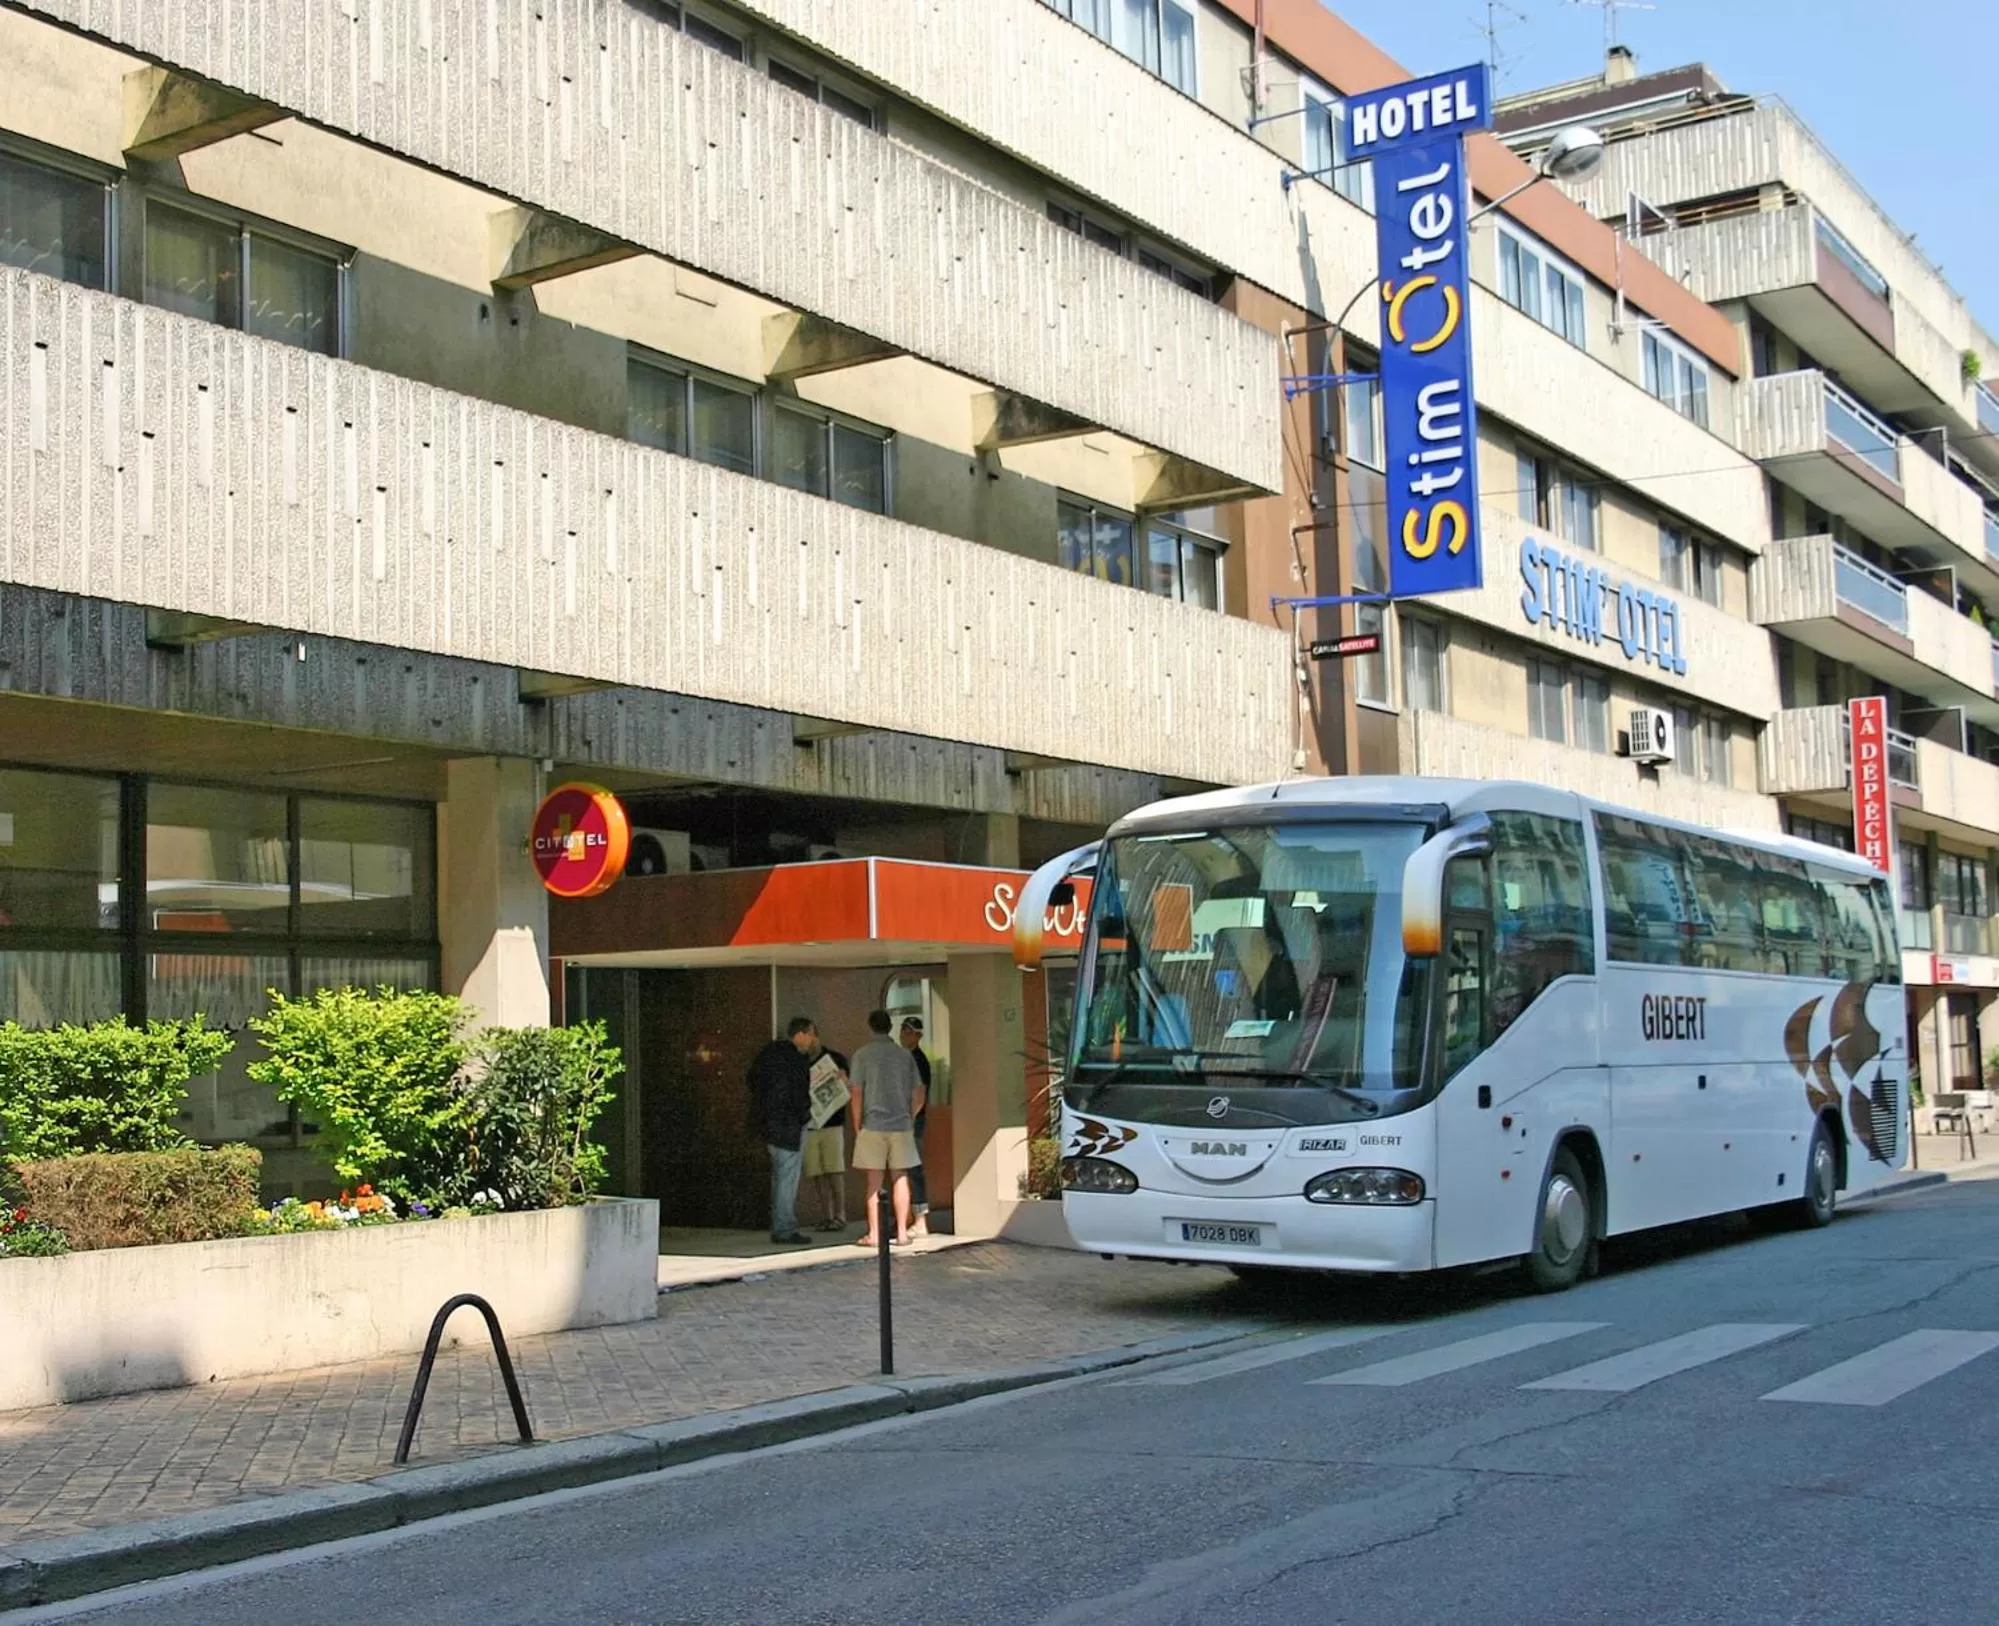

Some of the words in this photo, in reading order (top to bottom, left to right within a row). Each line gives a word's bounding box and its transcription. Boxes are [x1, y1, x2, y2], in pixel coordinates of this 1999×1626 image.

[1353, 80, 1477, 146] HOTEL
[1403, 378, 1469, 559] Stim
[1859, 701, 1877, 735] LA
[1641, 993, 1707, 1041] GIBERT
[1190, 1141, 1247, 1157] MAN
[1298, 1138, 1347, 1151] IRIZAR
[1359, 1134, 1403, 1147] GIBERT
[1190, 1225, 1225, 1241] 7028
